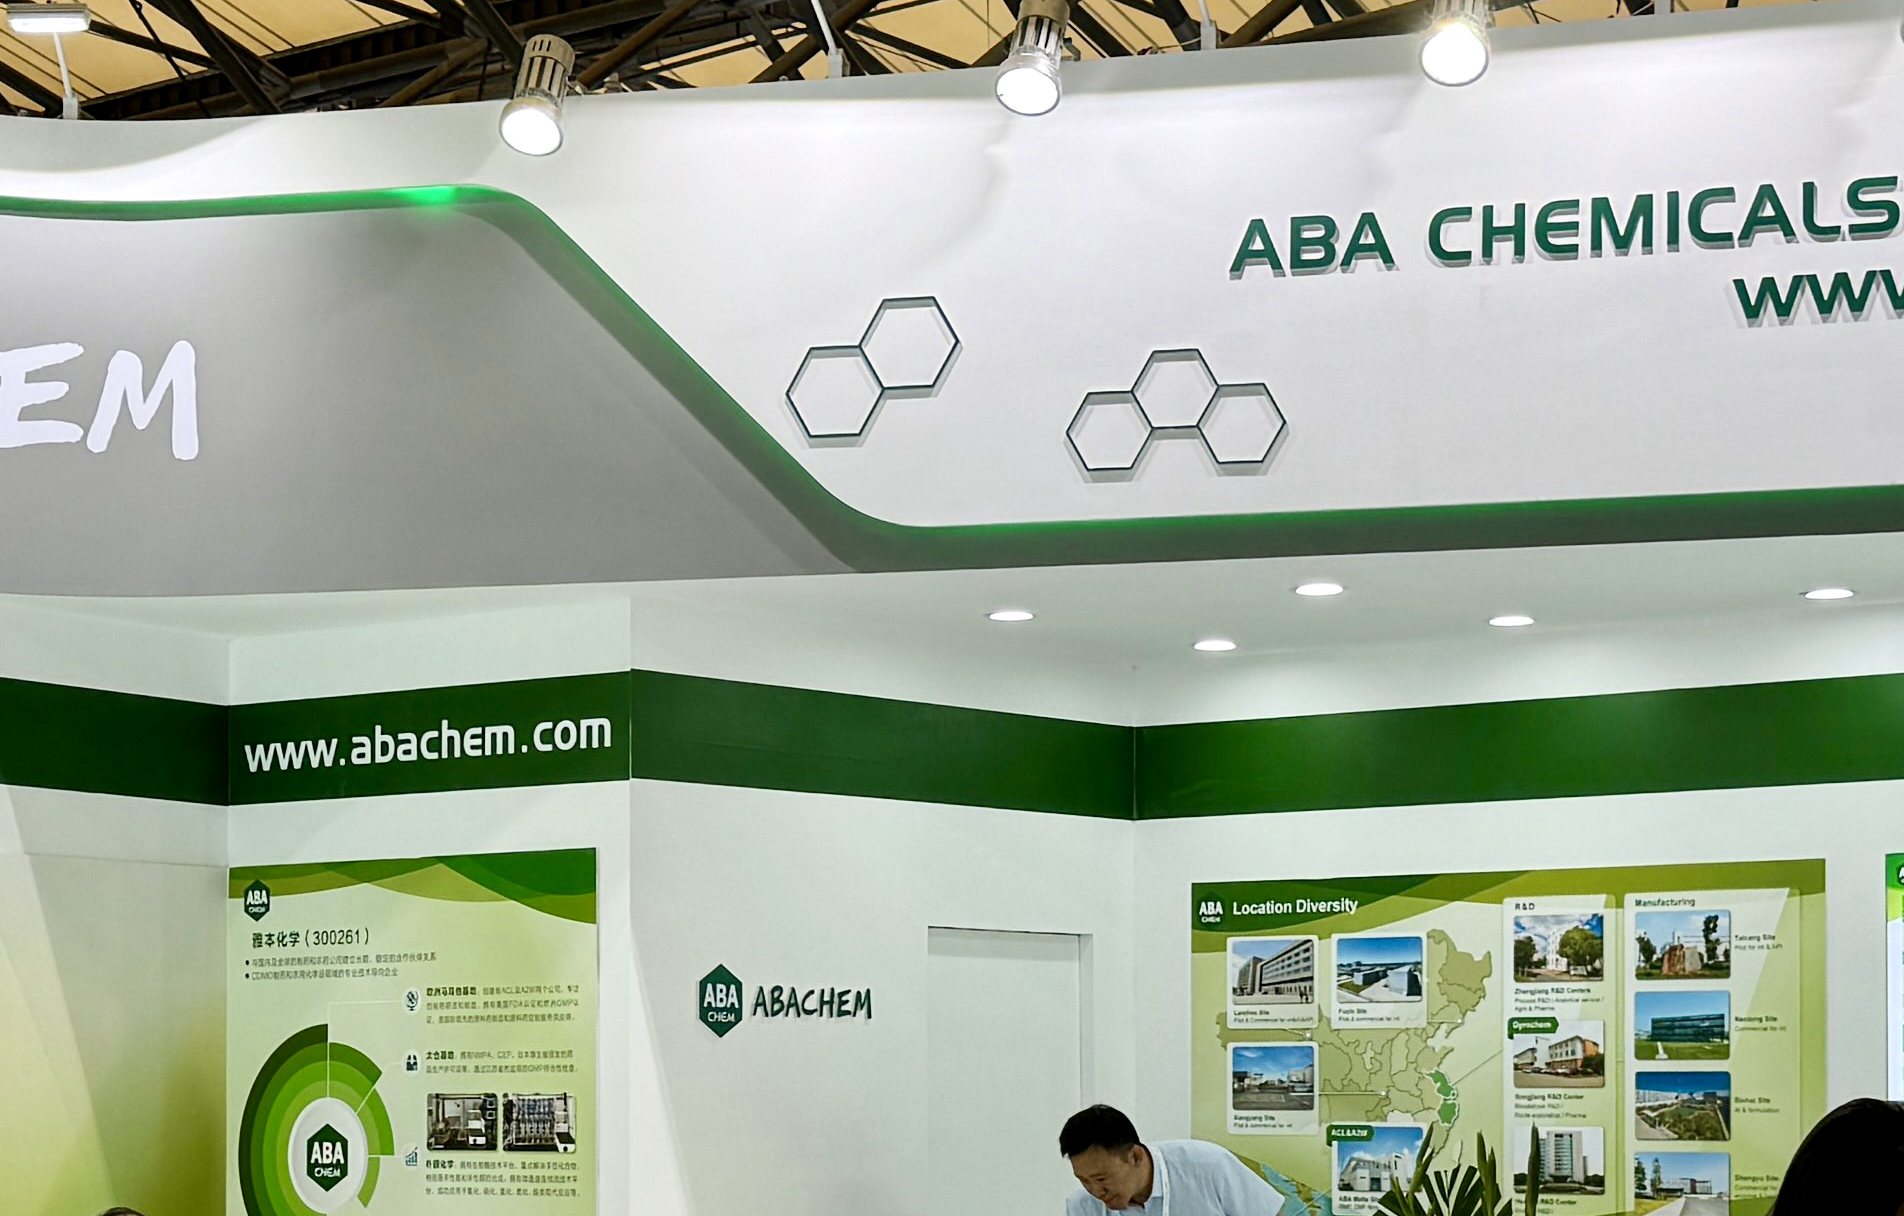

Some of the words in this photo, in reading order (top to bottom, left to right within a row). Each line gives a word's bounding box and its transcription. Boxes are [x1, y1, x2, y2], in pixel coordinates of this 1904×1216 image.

[1229, 212, 1396, 278] ABA
[1426, 175, 1900, 264] CHEMICALS
[244, 717, 612, 773] www.abachem.com
[247, 889, 268, 905] ABA
[1233, 901, 1293, 916] Location
[1296, 897, 1358, 915] Diversity
[1514, 902, 1535, 911] R&D
[1634, 897, 1696, 908] Manufacturing
[1199, 901, 1224, 916] ABA
[704, 983, 739, 1009] ABA
[753, 985, 872, 1020] ABACHEM
[707, 1011, 736, 1023] CHEM
[310, 1141, 345, 1164] ABA
